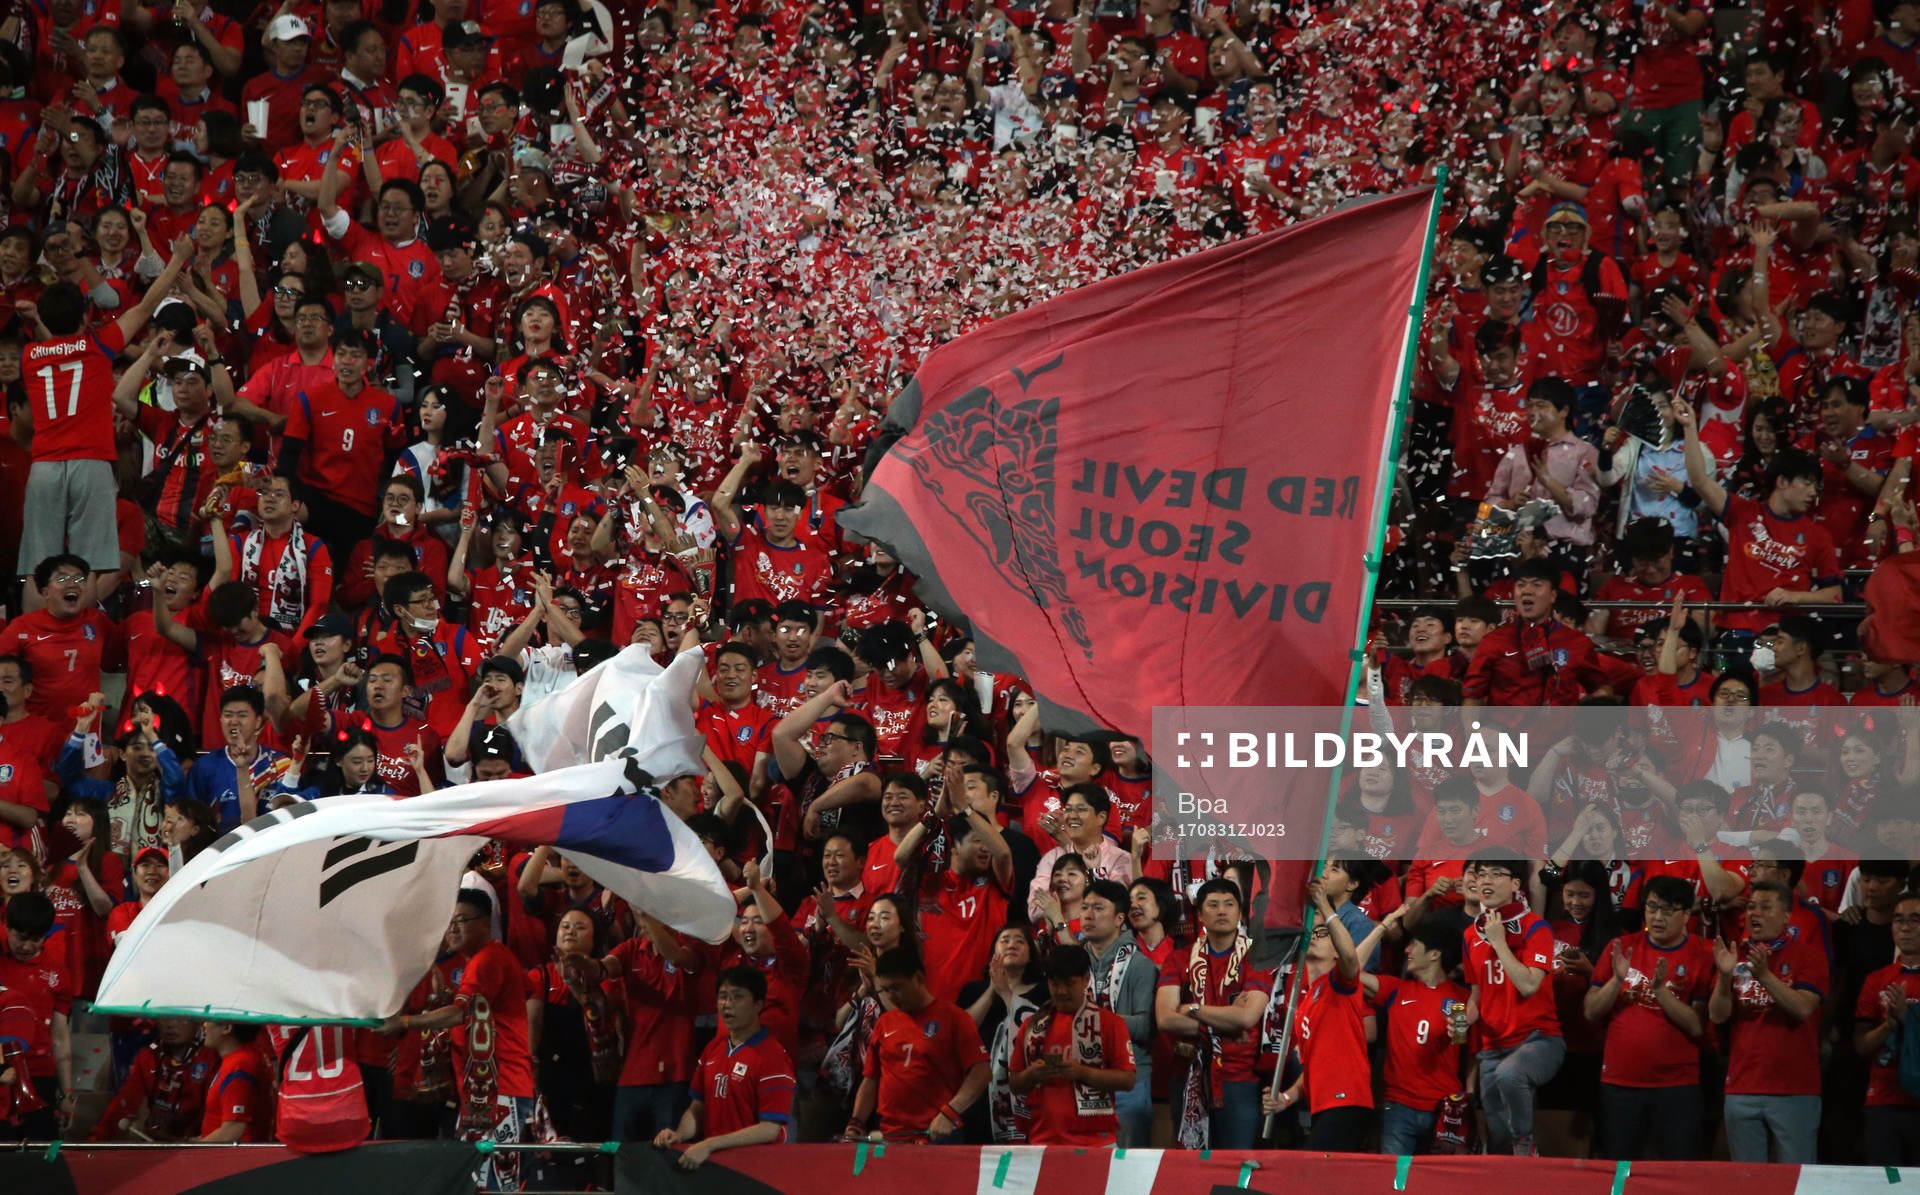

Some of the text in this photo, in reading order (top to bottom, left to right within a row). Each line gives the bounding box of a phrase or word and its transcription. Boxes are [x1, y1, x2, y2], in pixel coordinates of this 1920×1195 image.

[391, 273, 400, 294] 7
[1552, 306, 1572, 330] 21
[29, 340, 86, 359] CHUNGYONG
[36, 360, 84, 420] 17
[342, 428, 354, 451] 9
[63, 649, 77, 672] 7
[958, 896, 977, 918] 17
[1484, 960, 1504, 985] 13
[1416, 1020, 1430, 1044] 9
[287, 1025, 343, 1081] 20
[902, 1044, 914, 1068] 7
